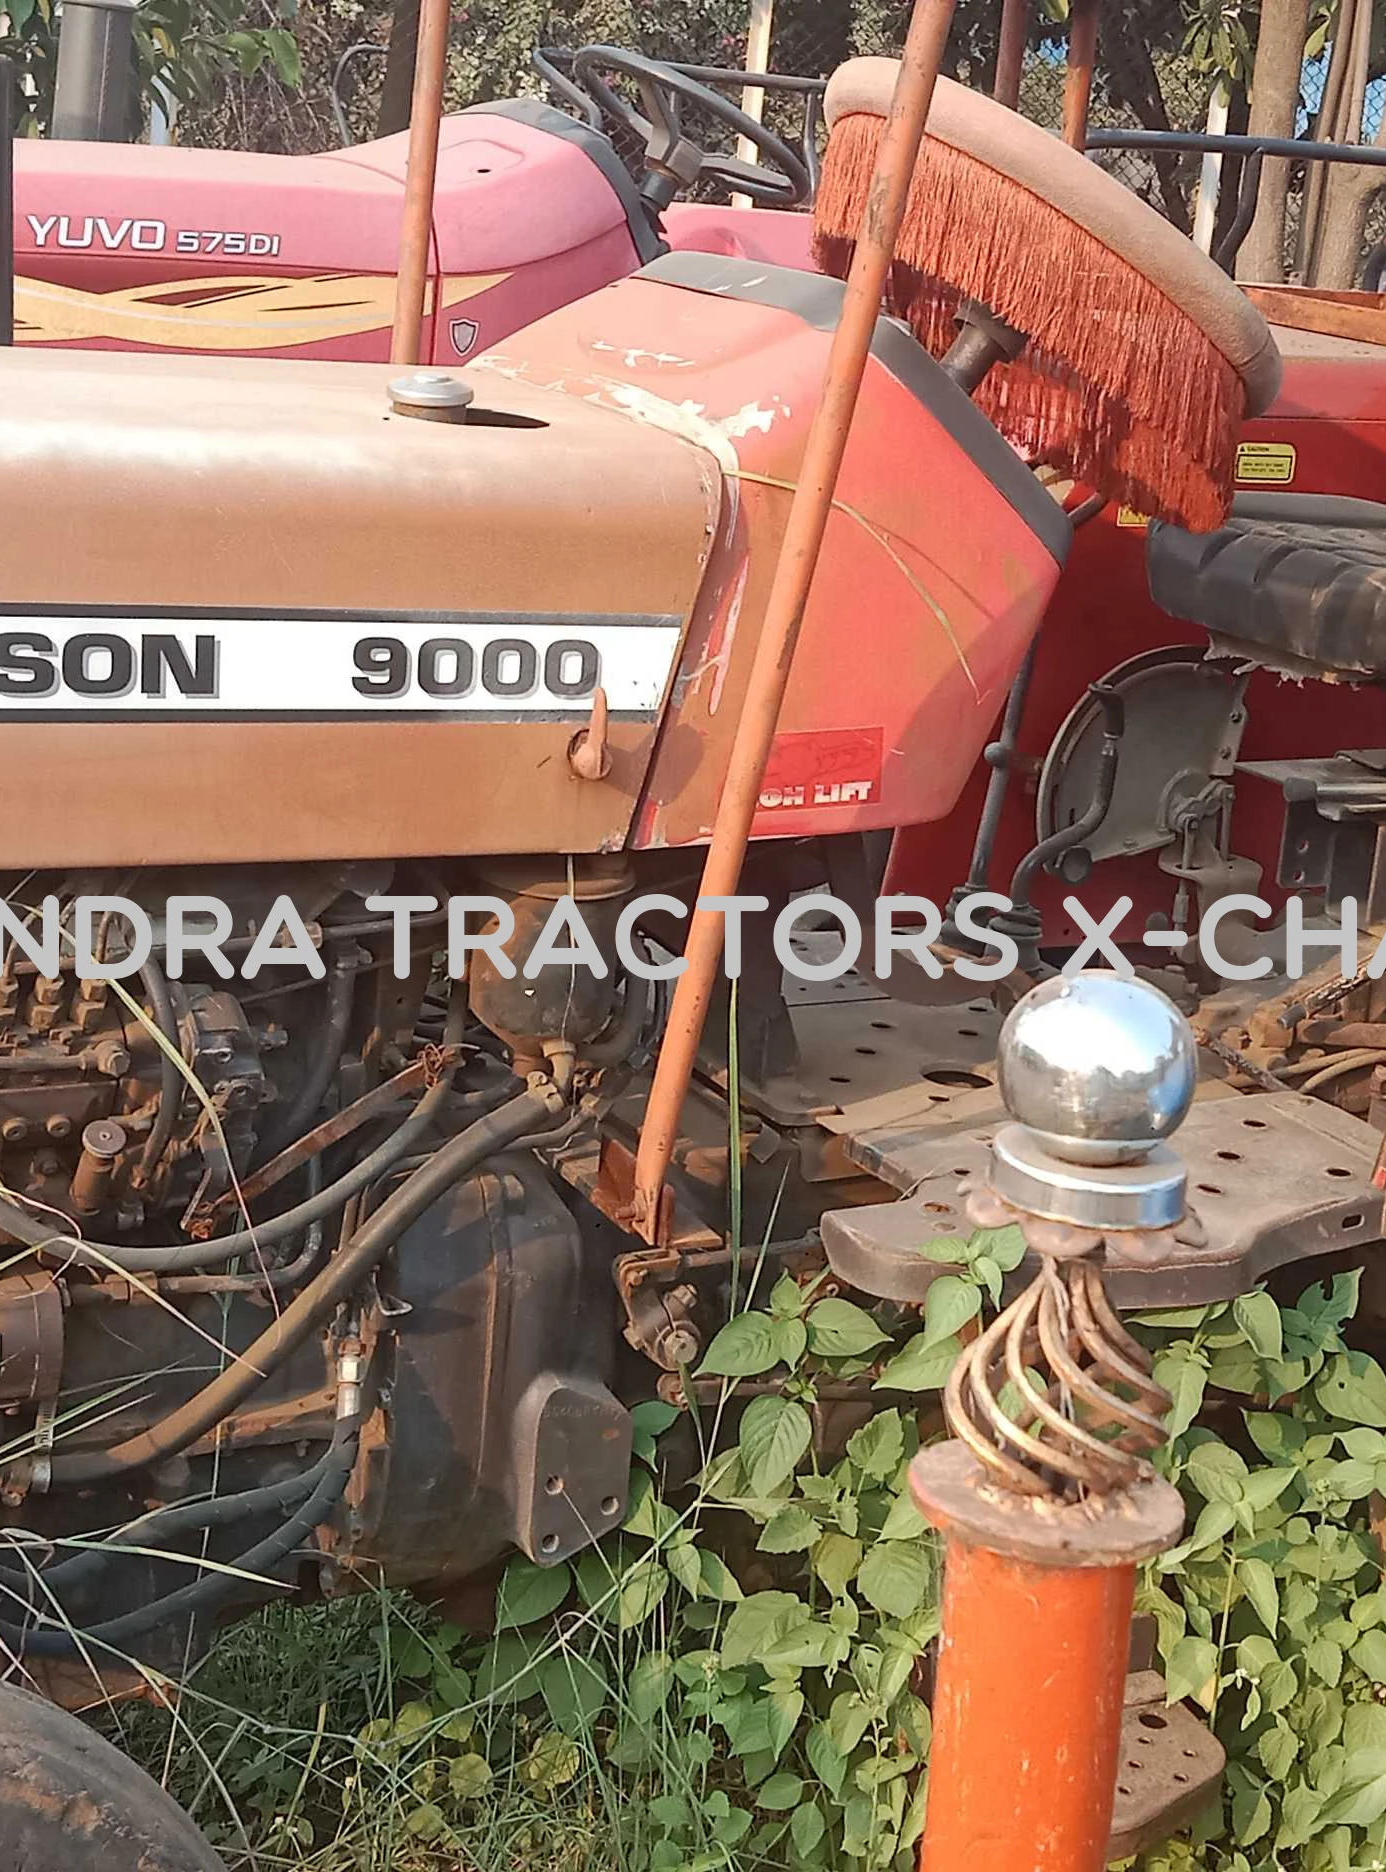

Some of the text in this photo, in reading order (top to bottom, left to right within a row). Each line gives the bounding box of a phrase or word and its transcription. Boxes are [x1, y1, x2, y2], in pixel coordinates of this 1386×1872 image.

[26, 214, 281, 256] YUVO 575DI
[352, 637, 602, 699] 9000
[814, 781, 872, 804] LIFT
